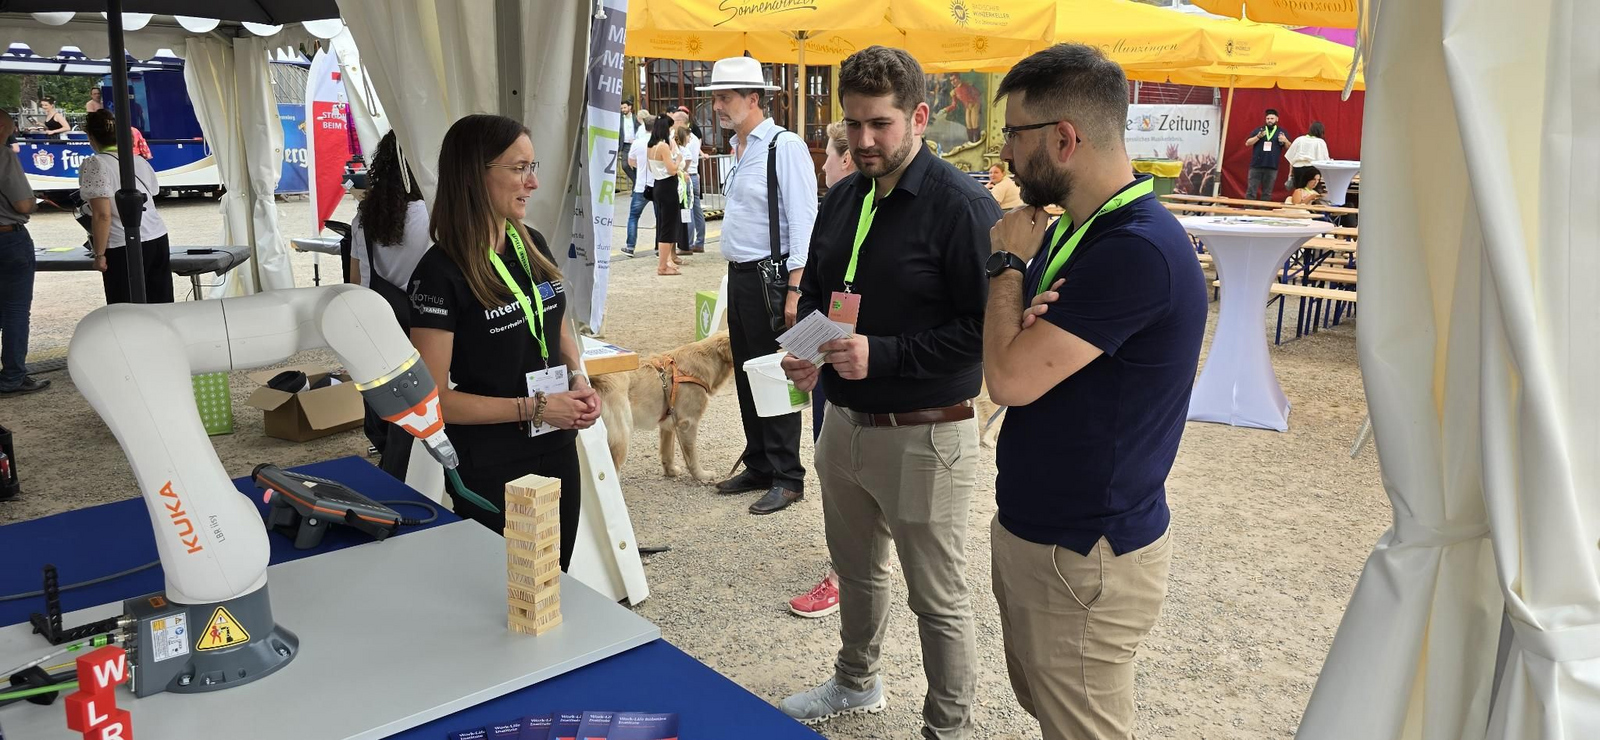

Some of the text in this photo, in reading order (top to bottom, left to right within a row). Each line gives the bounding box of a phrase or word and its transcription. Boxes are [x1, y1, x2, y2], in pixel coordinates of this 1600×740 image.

[323, 121, 342, 130] BEIM
[1158, 114, 1210, 136] Zeitung
[598, 180, 614, 206] R
[489, 317, 523, 334] Oberrhein
[159, 480, 203, 554] KUKA
[213, 527, 226, 543] LBR
[93, 654, 126, 688] W
[87, 701, 109, 727] L
[102, 722, 124, 740] R
